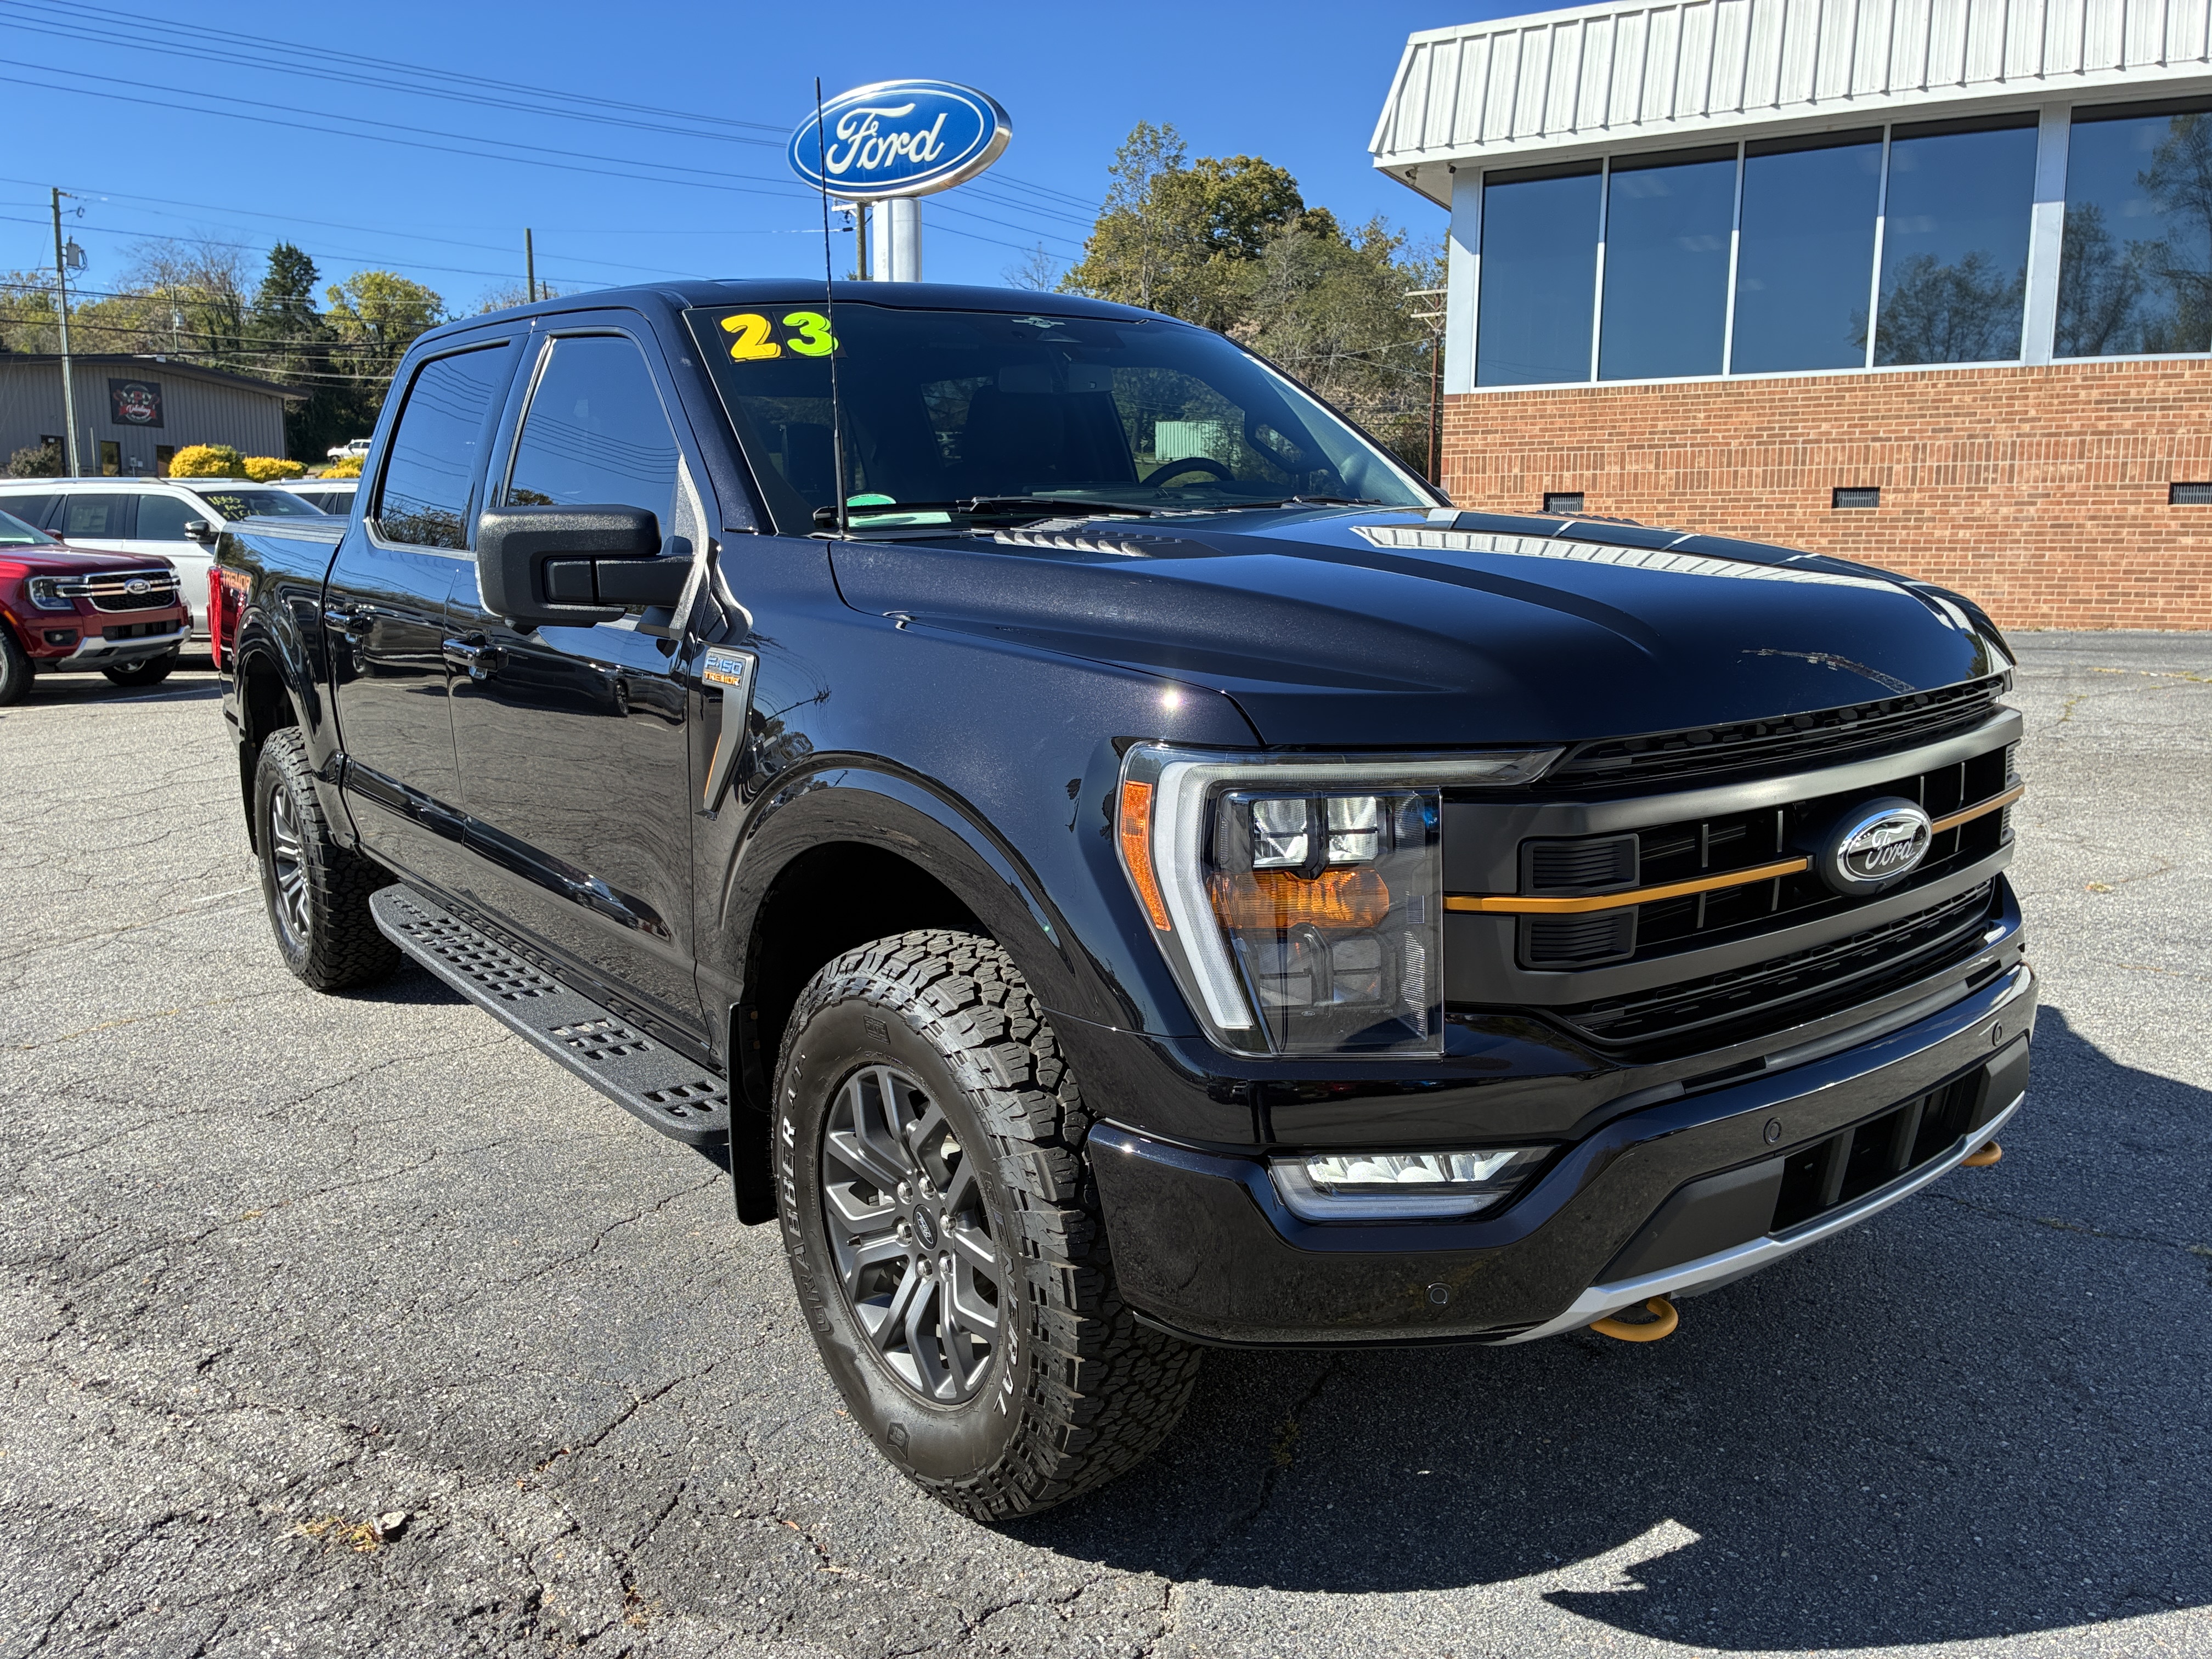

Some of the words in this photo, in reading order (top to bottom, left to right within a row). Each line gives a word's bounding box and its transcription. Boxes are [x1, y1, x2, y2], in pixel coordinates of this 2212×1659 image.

[826, 103, 948, 174] Ford
[720, 312, 839, 360] 23
[222, 570, 251, 594] TREMOR
[704, 671, 740, 686] TREMOR
[705, 657, 743, 675] F-150
[1865, 825, 1916, 870] Ford
[782, 1115, 832, 1332] GRABBER
[979, 1169, 1019, 1419] GENERAL
